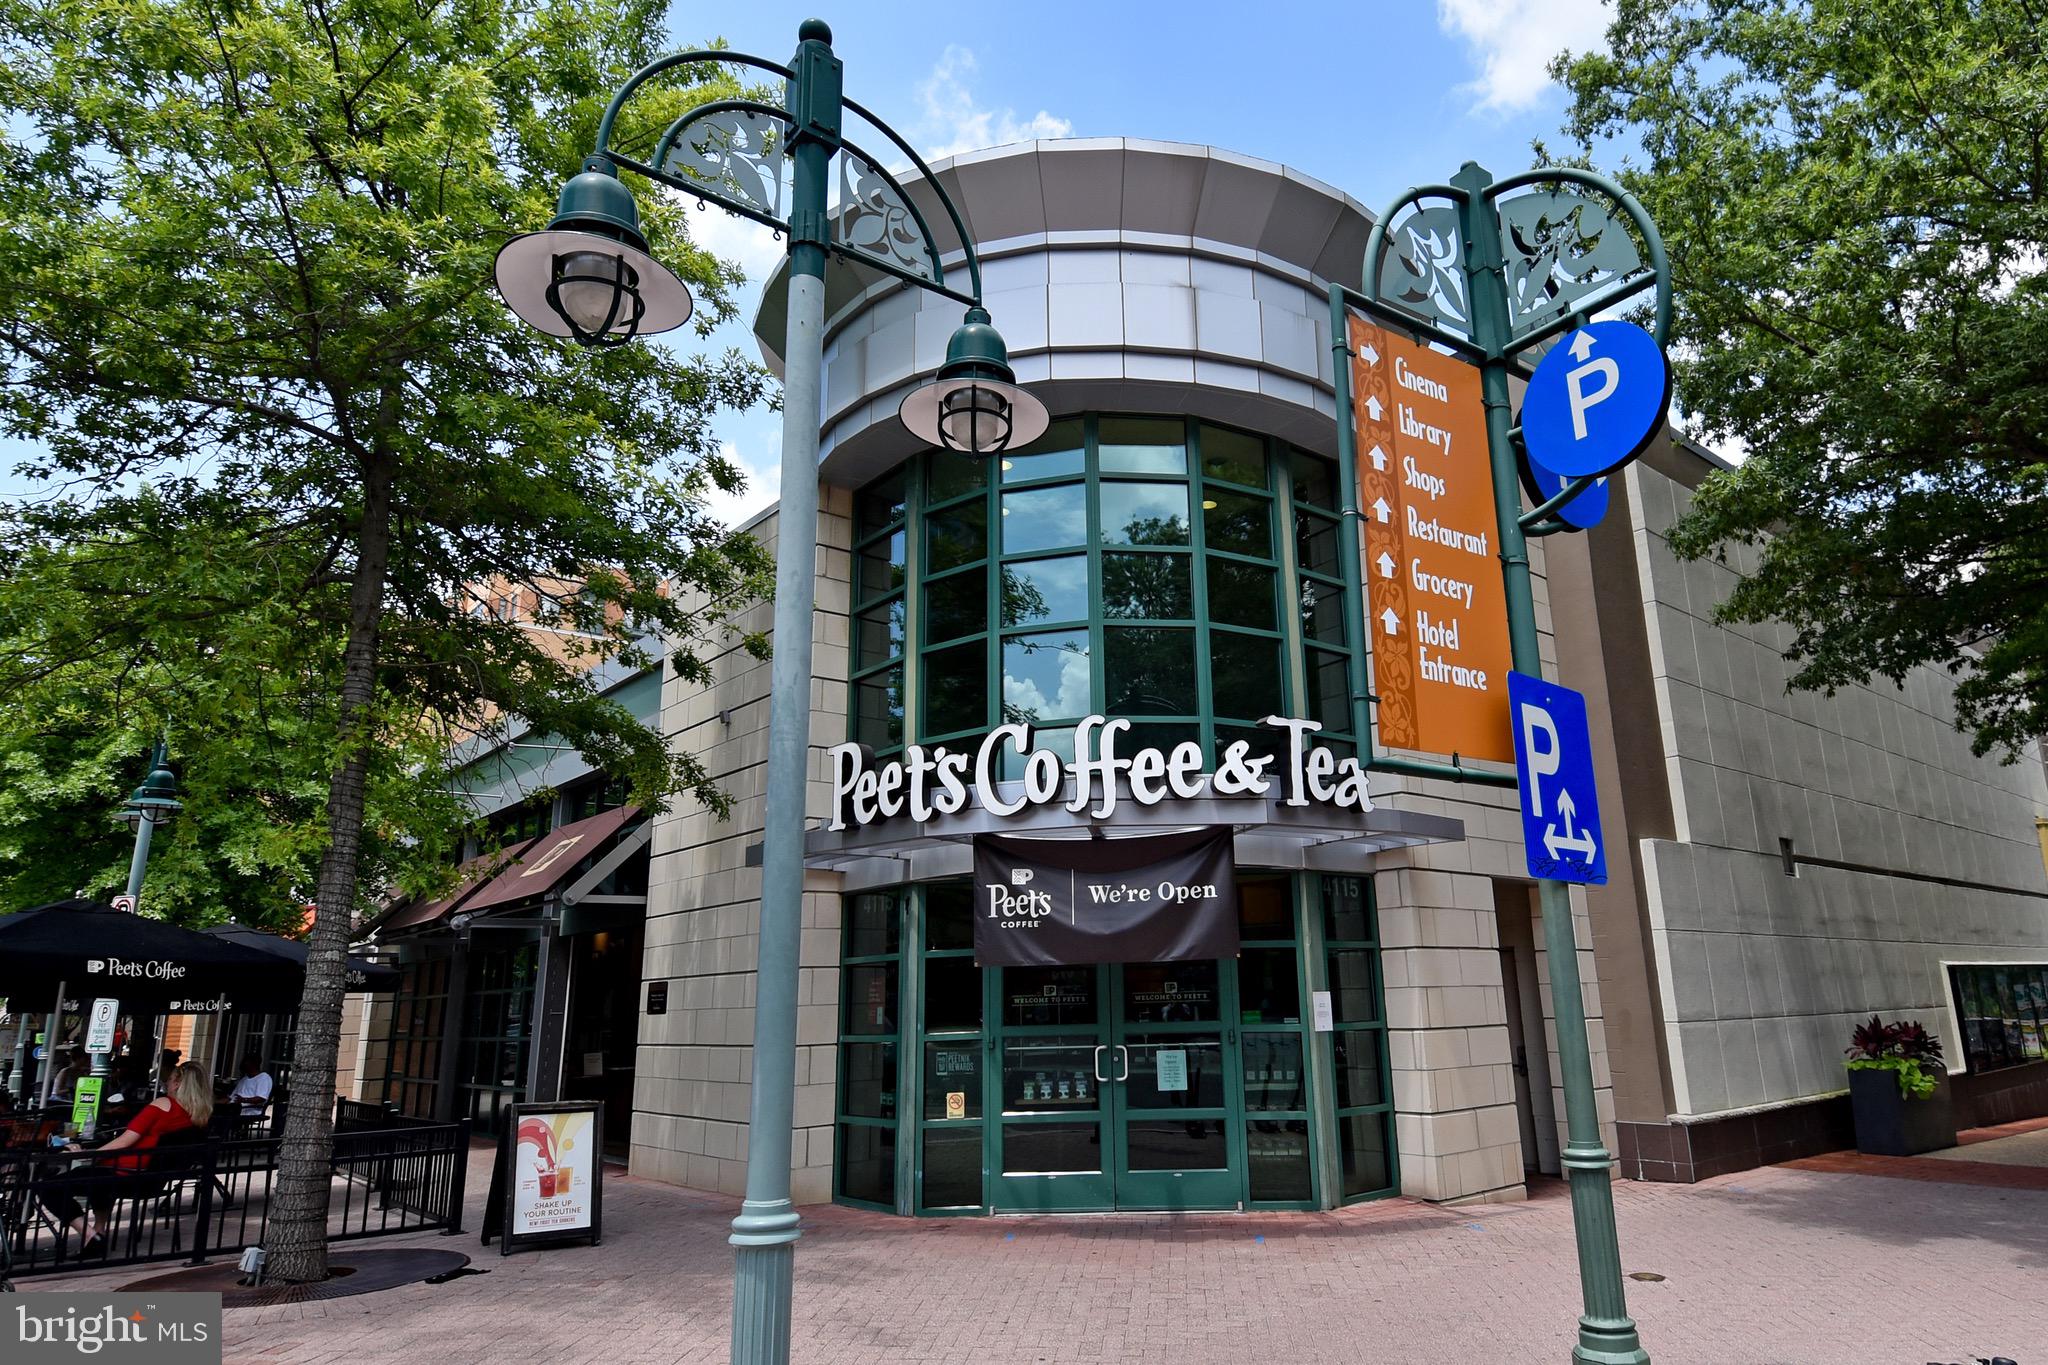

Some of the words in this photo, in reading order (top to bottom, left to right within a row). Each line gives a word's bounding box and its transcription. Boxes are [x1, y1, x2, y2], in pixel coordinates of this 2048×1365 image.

[1395, 356, 1448, 402] Cinema
[1566, 356, 1620, 440] P
[1398, 402, 1452, 456] Library
[1403, 455, 1446, 500] Shops
[1407, 505, 1487, 557] Restaurant
[1412, 558, 1473, 608] Grocery
[1417, 611, 1460, 650] Hotel
[1419, 647, 1488, 690] Entrance
[827, 741, 970, 831] Peet's
[973, 715, 1206, 819] Coffee
[1212, 739, 1275, 795] &
[1262, 715, 1376, 813] Tea
[1521, 703, 1562, 818] P
[986, 884, 1052, 918] Peet's
[1088, 884, 1151, 904] We're
[1157, 881, 1218, 904] Open
[1323, 877, 1359, 898] 4115
[1001, 920, 1040, 928] COFFEE
[107, 958, 143, 977] Peet's
[145, 960, 186, 980] Coffee
[1013, 996, 1049, 1004] WELCOME
[1134, 993, 1170, 1001] WELCOME
[524, 1210, 546, 1218] YOUR
[548, 1207, 582, 1216] ROUTINE
[534, 1201, 560, 1209] SHAKE
